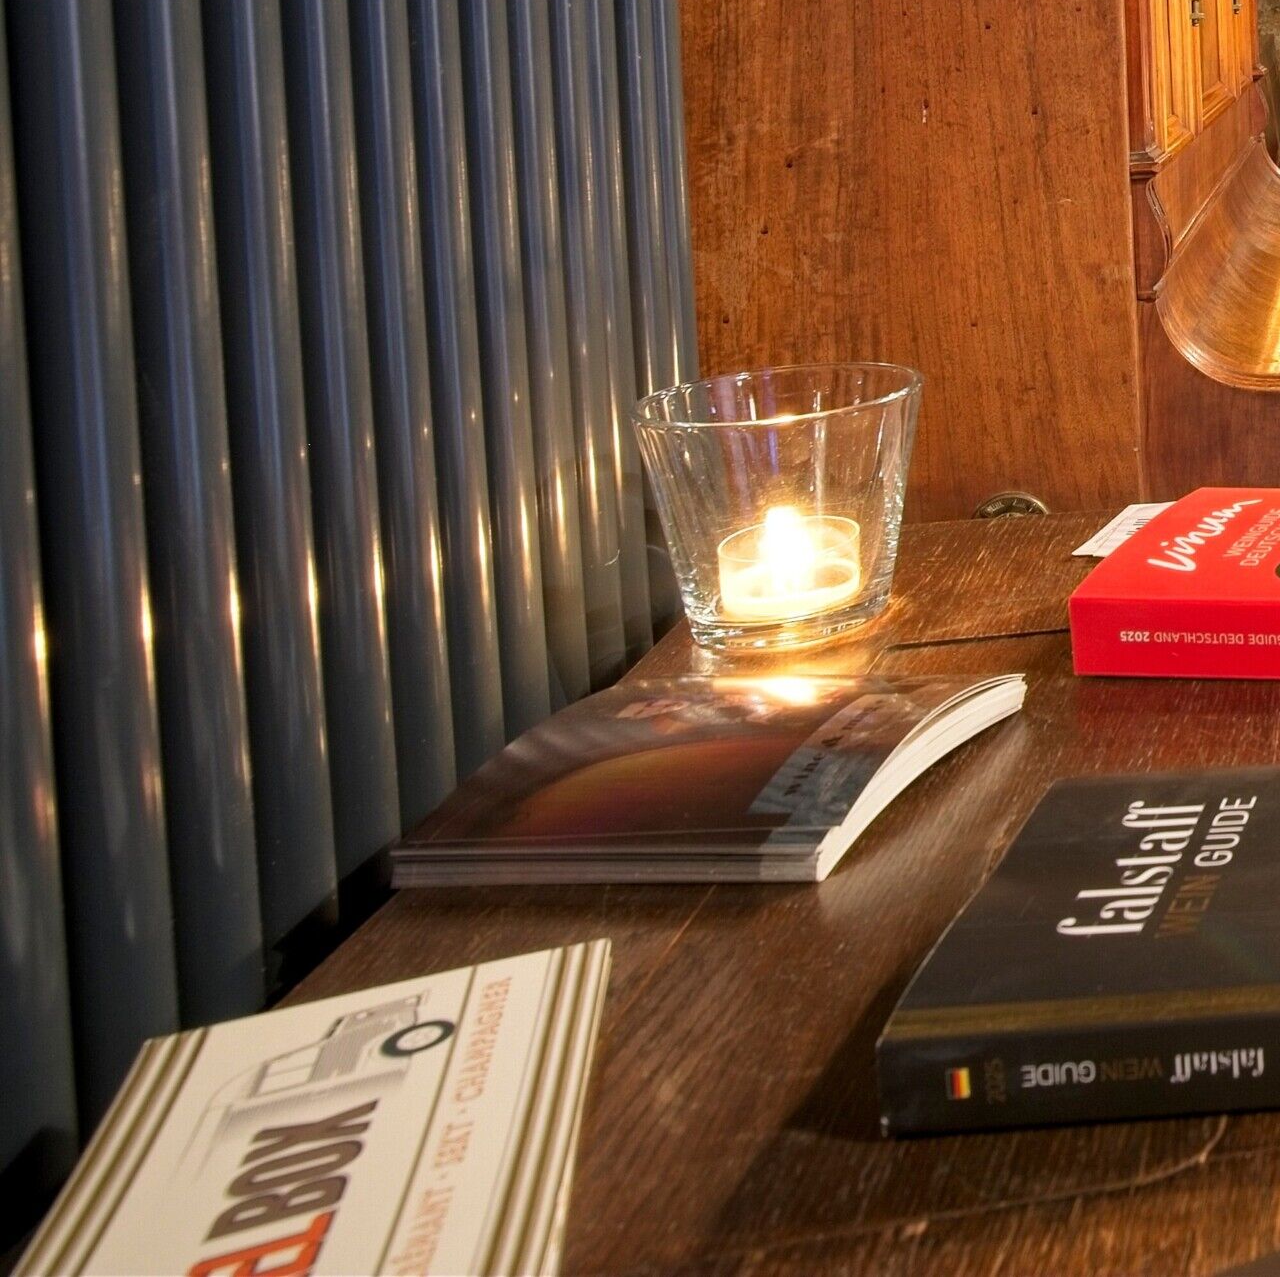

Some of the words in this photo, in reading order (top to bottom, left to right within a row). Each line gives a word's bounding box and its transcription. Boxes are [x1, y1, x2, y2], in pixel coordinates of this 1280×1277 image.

[1120, 630, 1151, 643] 2025
[1154, 632, 1245, 646] DEUTSCHLAND
[1056, 800, 1207, 937] falstaff
[1154, 874, 1222, 938] WEIN
[1194, 795, 1258, 868] GUIDE
[455, 975, 513, 1105] CHAMPAGNER
[1021, 1059, 1097, 1089] GUIDE
[1169, 1047, 1265, 1085] falstaff
